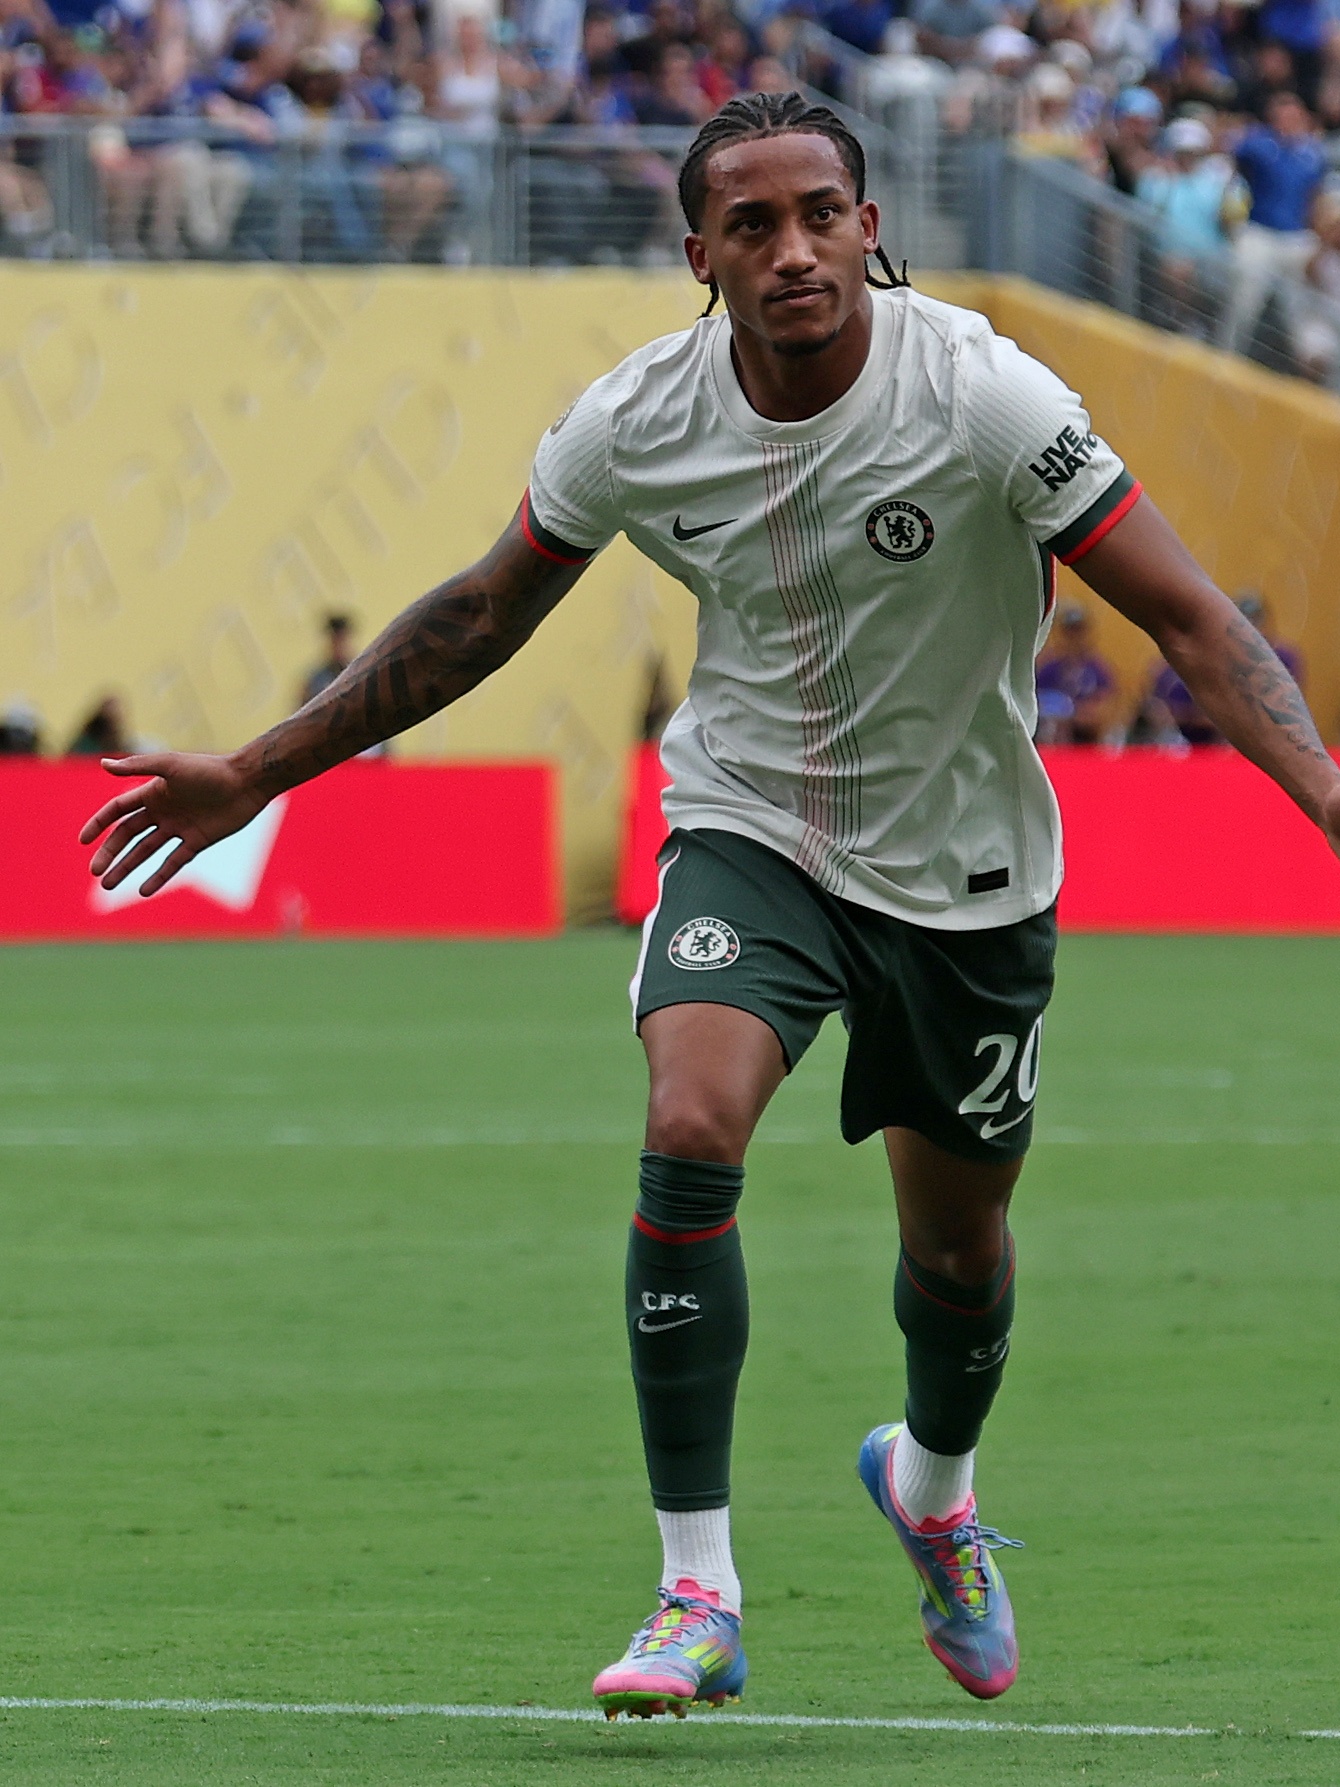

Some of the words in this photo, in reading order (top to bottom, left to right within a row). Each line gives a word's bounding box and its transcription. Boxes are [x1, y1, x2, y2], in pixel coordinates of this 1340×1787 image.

[1028, 424, 1080, 480] LIVE
[1043, 430, 1098, 493] NATIO
[873, 502, 918, 518] CHELSEA
[686, 919, 732, 938] CHELSEA
[957, 1013, 1043, 1116] 20
[641, 1290, 700, 1311] CFC
